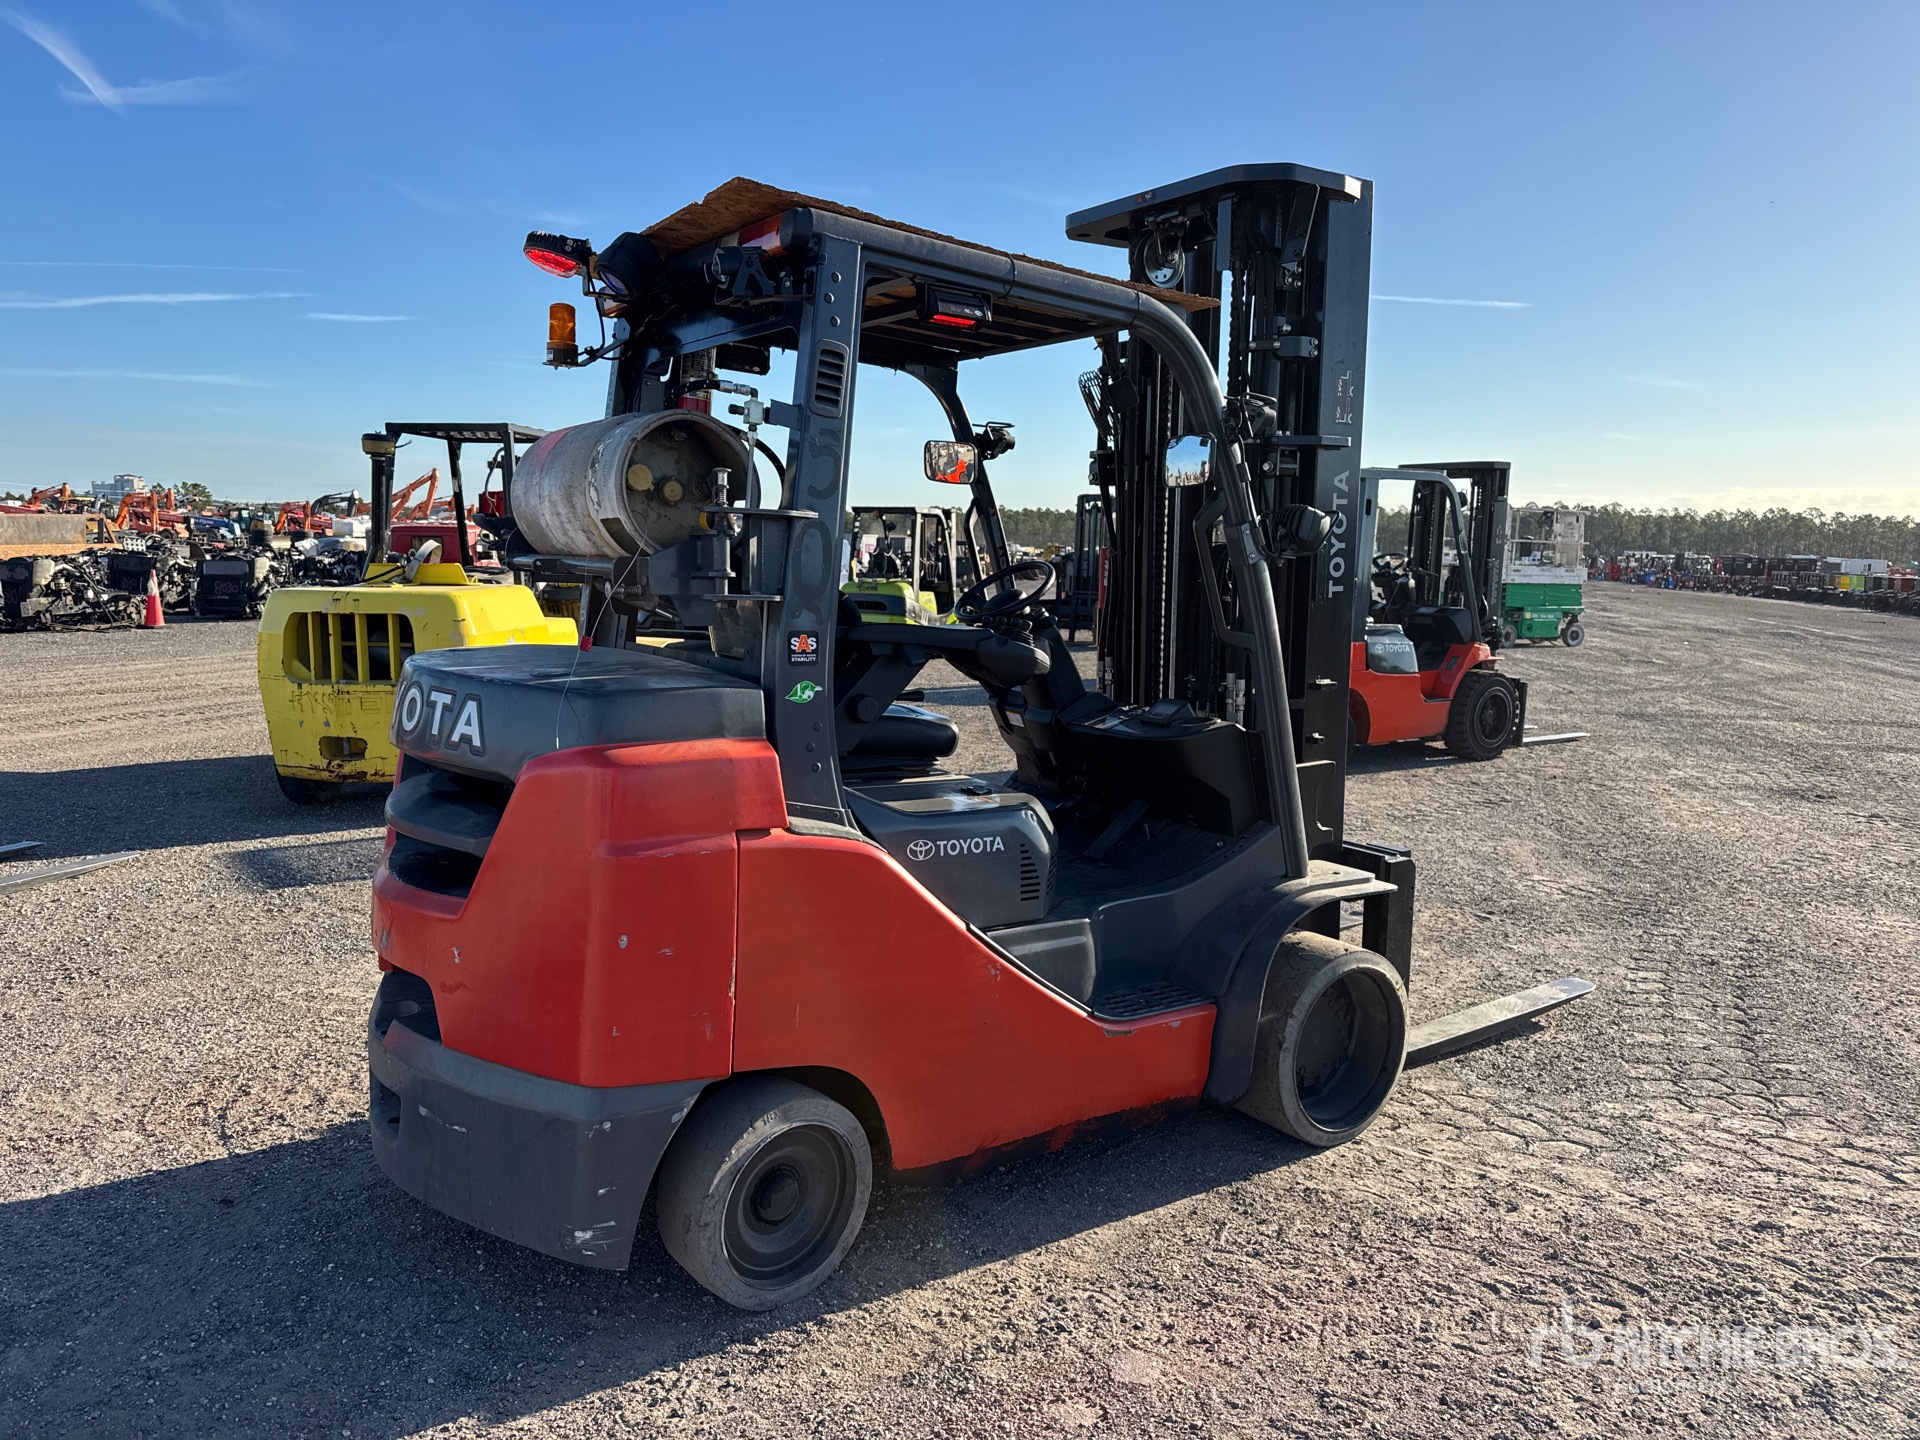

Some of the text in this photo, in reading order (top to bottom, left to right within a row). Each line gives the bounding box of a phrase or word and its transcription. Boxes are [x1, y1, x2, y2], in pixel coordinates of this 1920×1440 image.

[1328, 470, 1350, 598] TOYOTA
[1490, 559, 1500, 605] TOYOTA
[790, 634, 817, 653] SAS
[1385, 644, 1410, 653] TOYOTA
[936, 836, 1005, 857] TOYOTA
